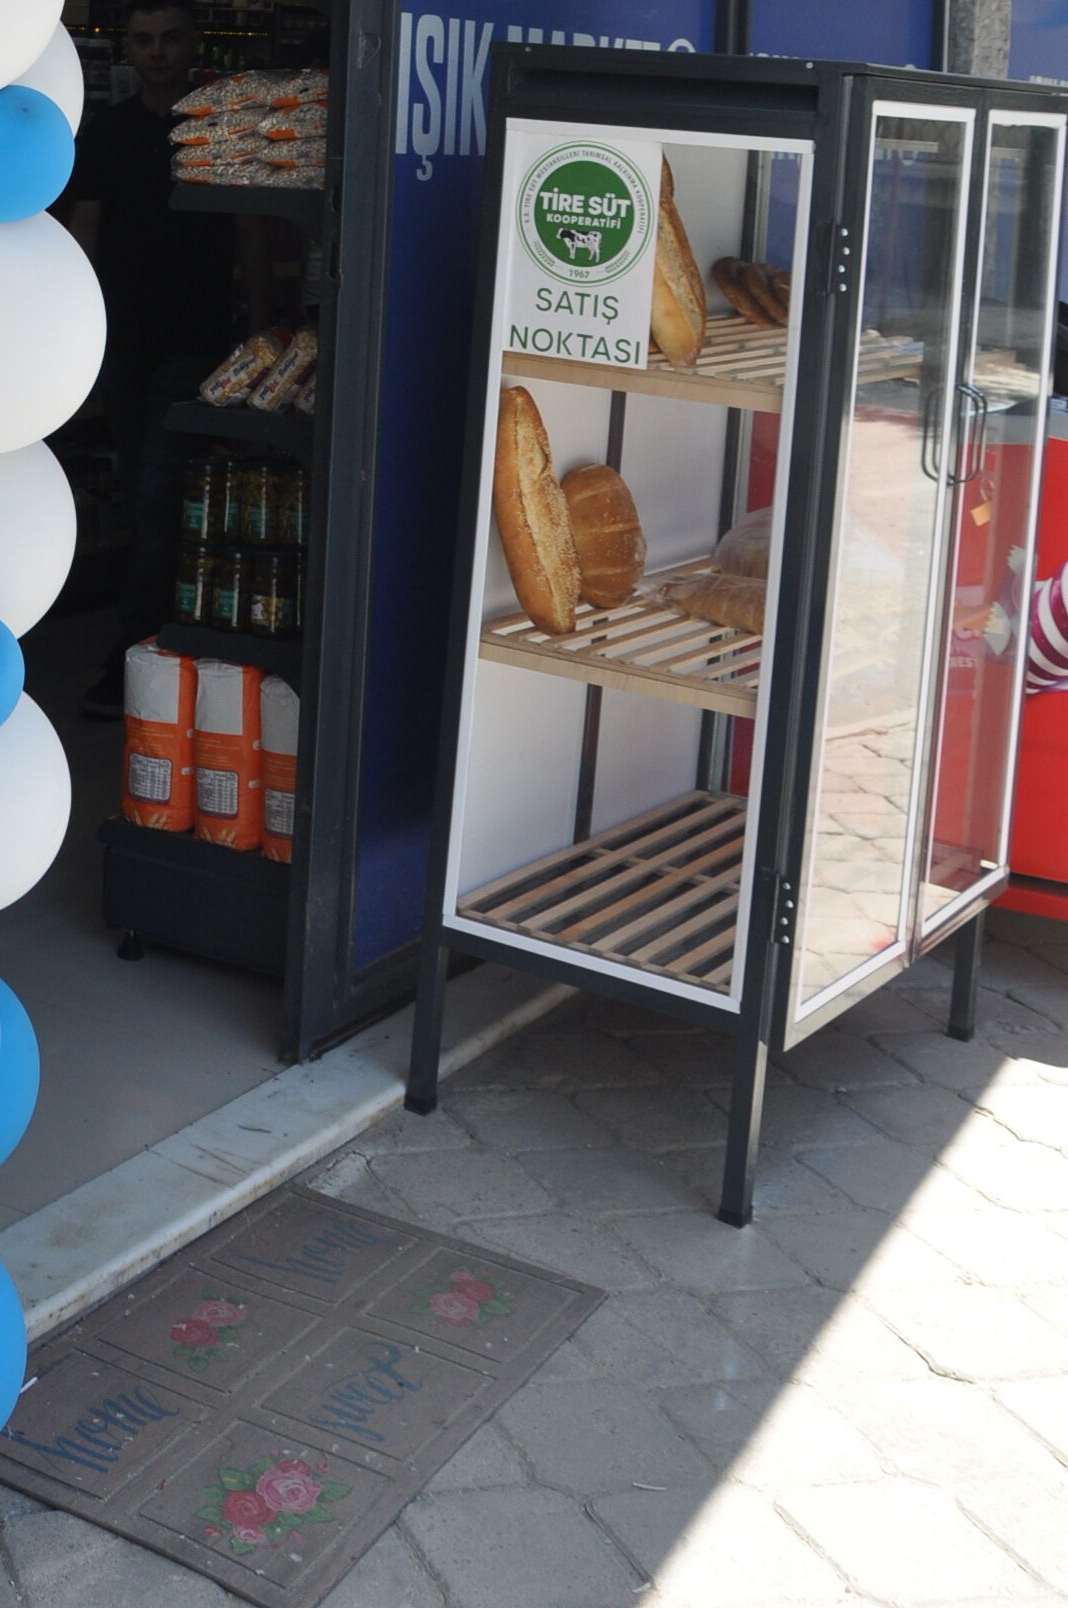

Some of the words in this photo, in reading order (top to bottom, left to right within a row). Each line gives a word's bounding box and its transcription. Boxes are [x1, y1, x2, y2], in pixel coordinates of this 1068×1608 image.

[395, 11, 495, 181] IŞIK
[540, 187, 585, 214] TİRE
[589, 192, 631, 218] SÜT
[546, 213, 621, 230] KOOPERATİFİ
[569, 268, 590, 279] 1967
[535, 287, 619, 326] SATIŞ
[509, 324, 641, 365] NOKTASI
